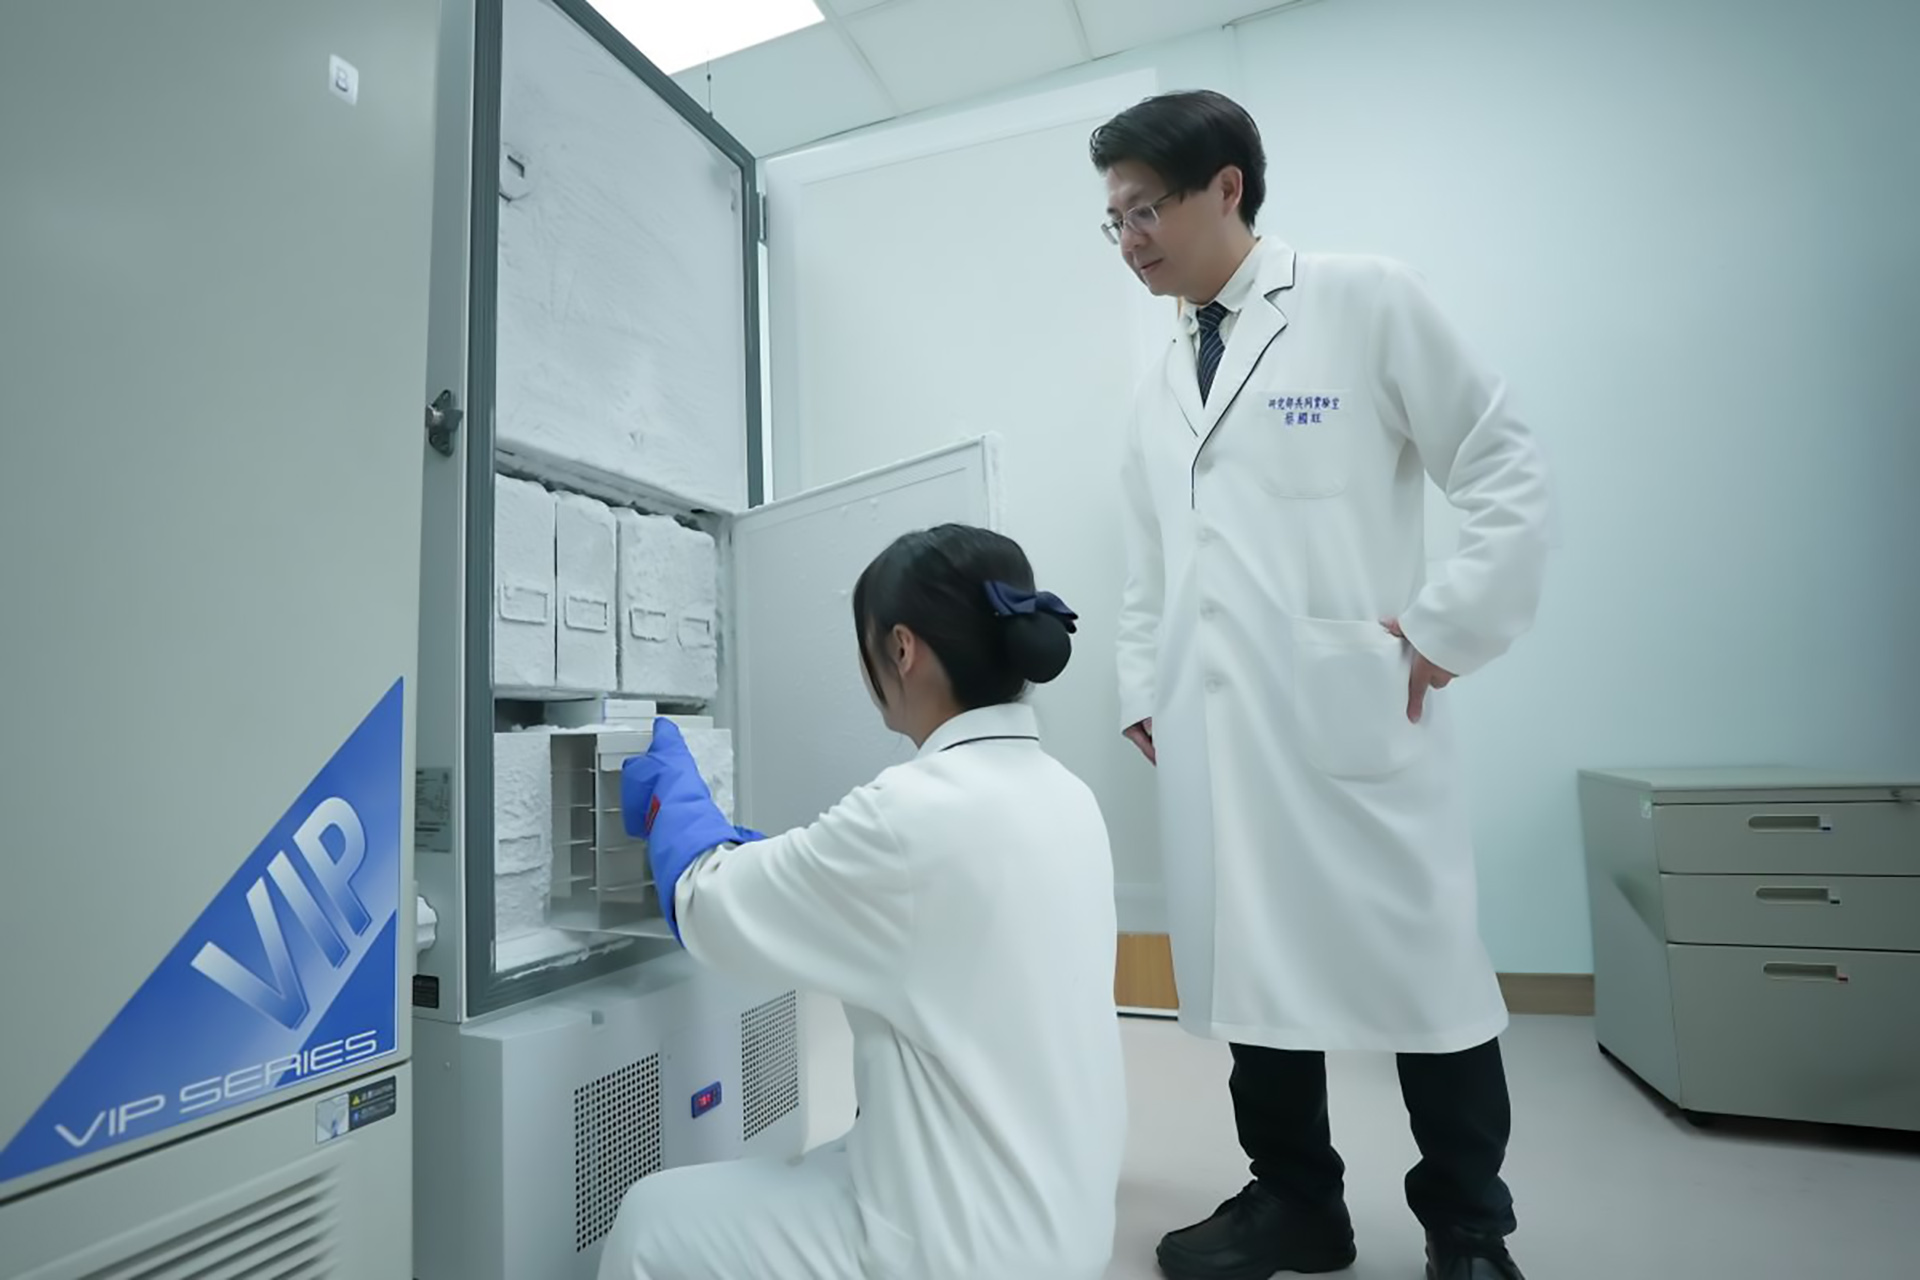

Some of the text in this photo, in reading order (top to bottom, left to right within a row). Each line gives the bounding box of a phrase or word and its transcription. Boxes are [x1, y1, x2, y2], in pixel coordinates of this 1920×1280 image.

[190, 797, 372, 1030] VIP
[55, 1030, 378, 1147] VIP SERIES
